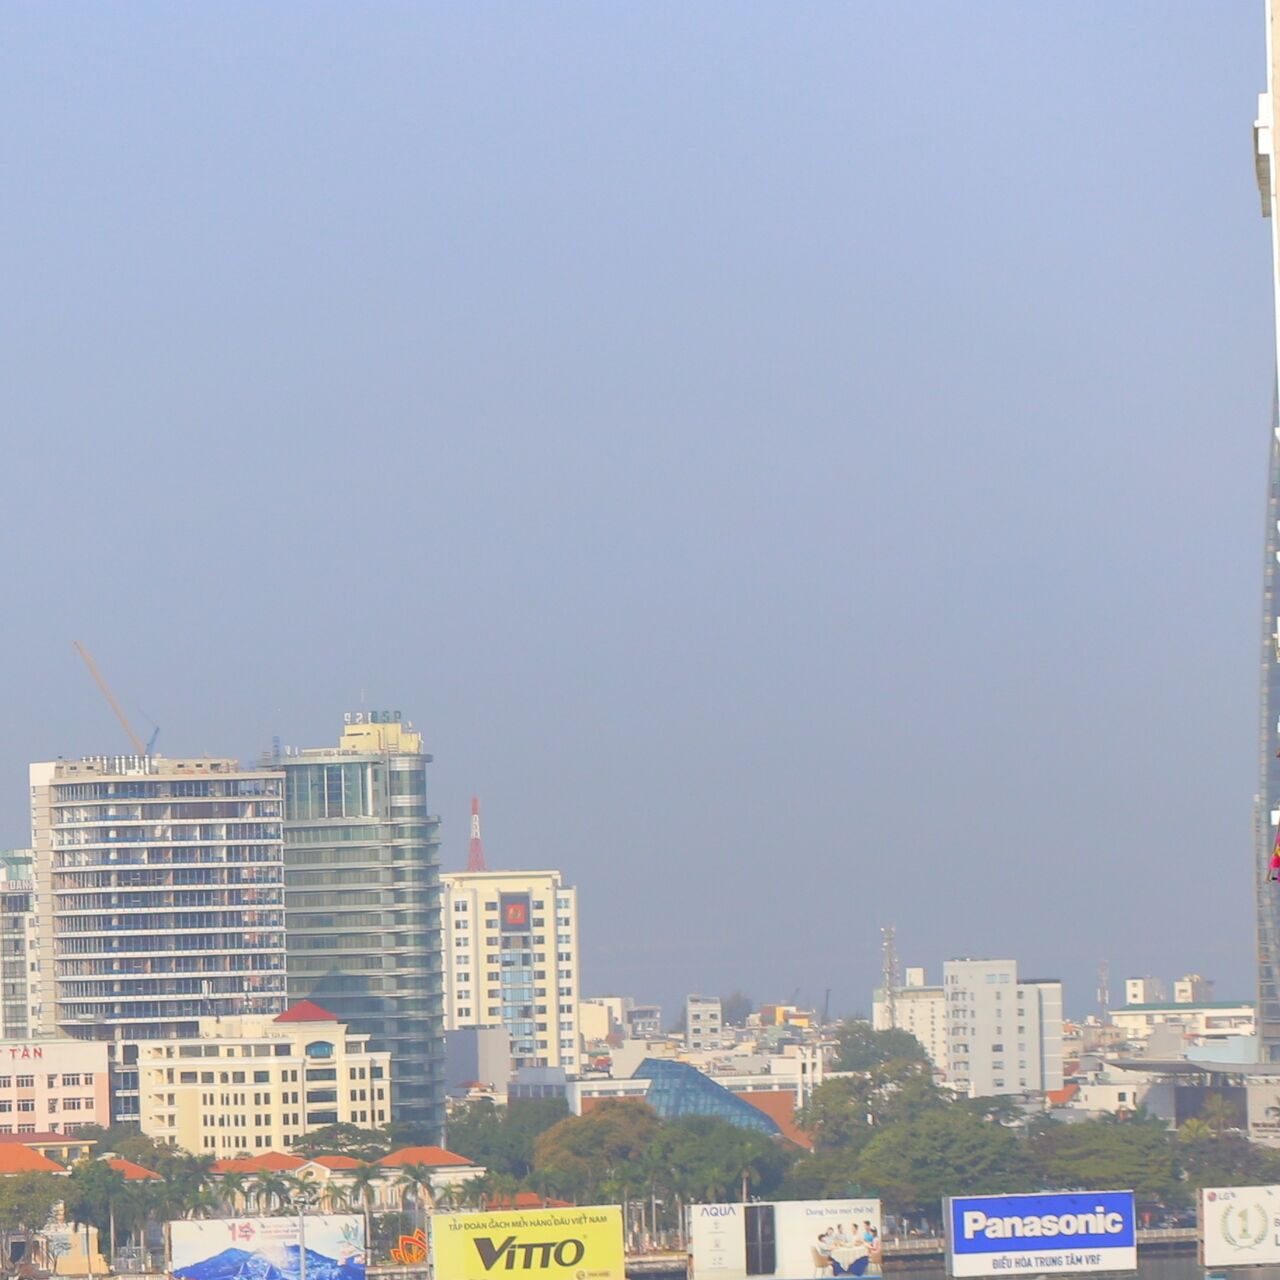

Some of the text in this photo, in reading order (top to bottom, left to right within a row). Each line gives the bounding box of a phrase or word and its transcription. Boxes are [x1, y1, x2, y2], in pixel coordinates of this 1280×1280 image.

[1218, 1192, 1230, 1201] LG
[700, 1206, 737, 1217] AQUA
[589, 1214, 608, 1224] NAM
[963, 1206, 1123, 1240] Panasonic
[1035, 1255, 1063, 1268] TRUNG
[1065, 1252, 1083, 1266] TÂM
[1085, 1254, 1101, 1265] VRF
